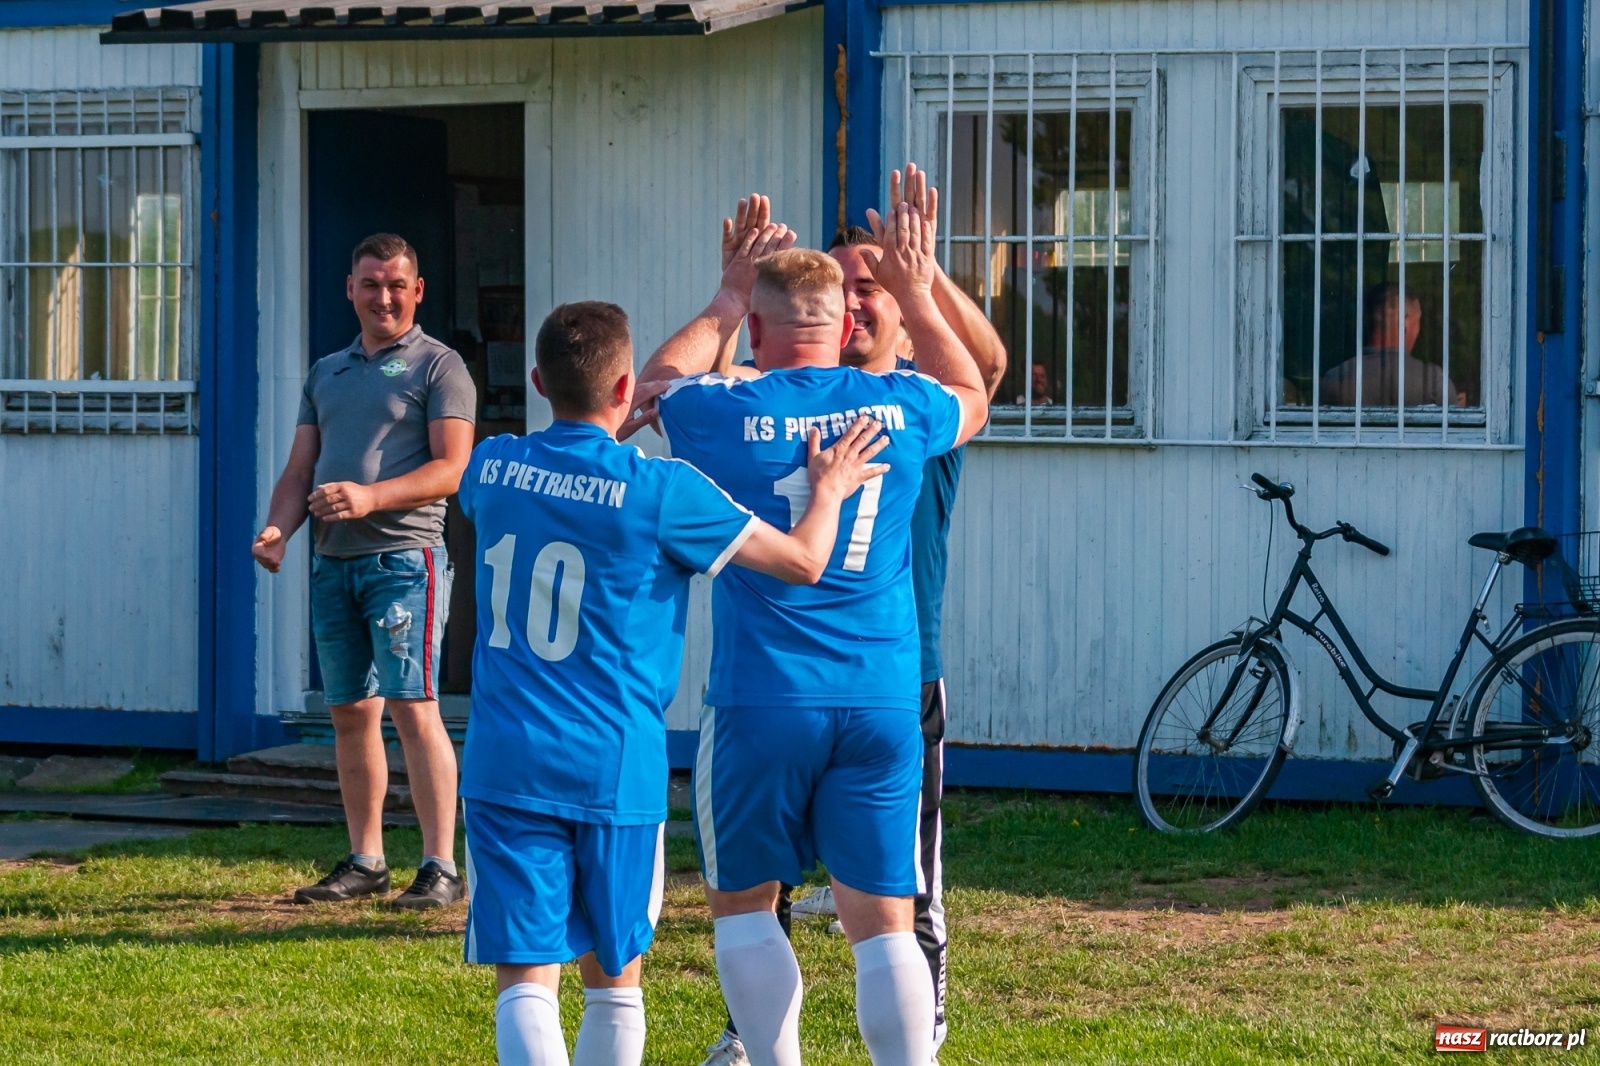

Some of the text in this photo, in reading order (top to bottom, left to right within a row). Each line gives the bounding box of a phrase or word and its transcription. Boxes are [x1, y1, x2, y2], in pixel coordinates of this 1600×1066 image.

[743, 416, 775, 442] KS
[479, 458, 628, 509] KS PIETRASZYN
[484, 533, 586, 662] 10
[1311, 582, 1325, 603] Retro
[1315, 629, 1347, 669] eurobike
